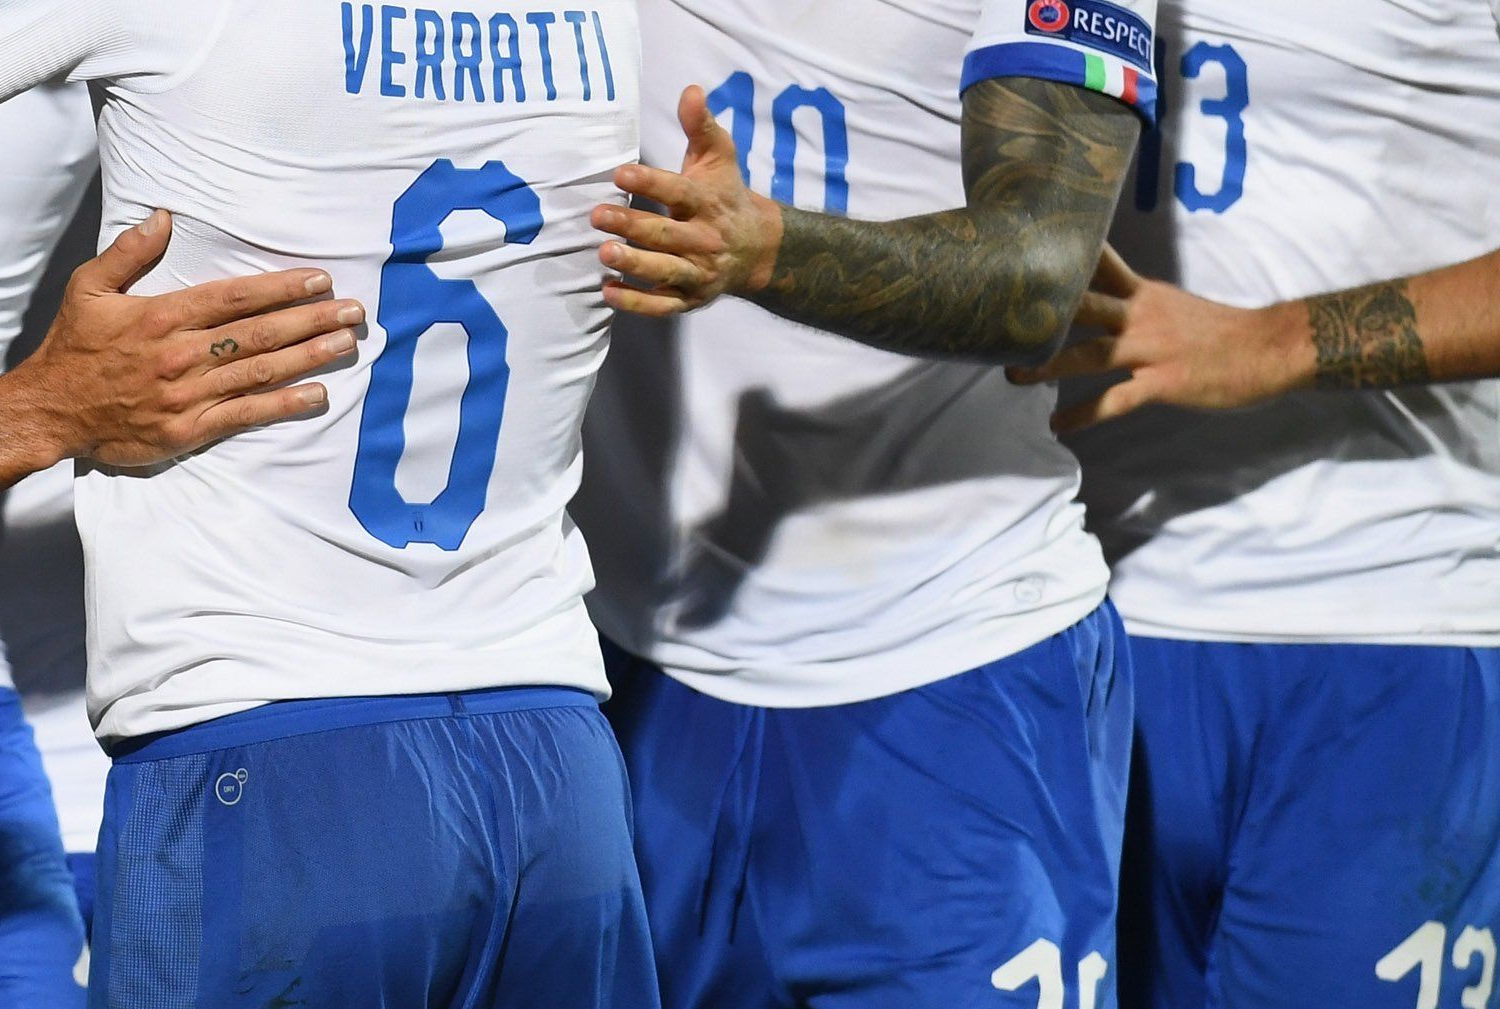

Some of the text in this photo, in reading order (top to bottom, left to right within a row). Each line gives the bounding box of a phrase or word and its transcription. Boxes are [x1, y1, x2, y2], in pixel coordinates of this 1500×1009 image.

[340, 2, 616, 104] VERRATTI
[1073, 7, 1152, 60] RESPECT
[348, 158, 544, 551] 6
